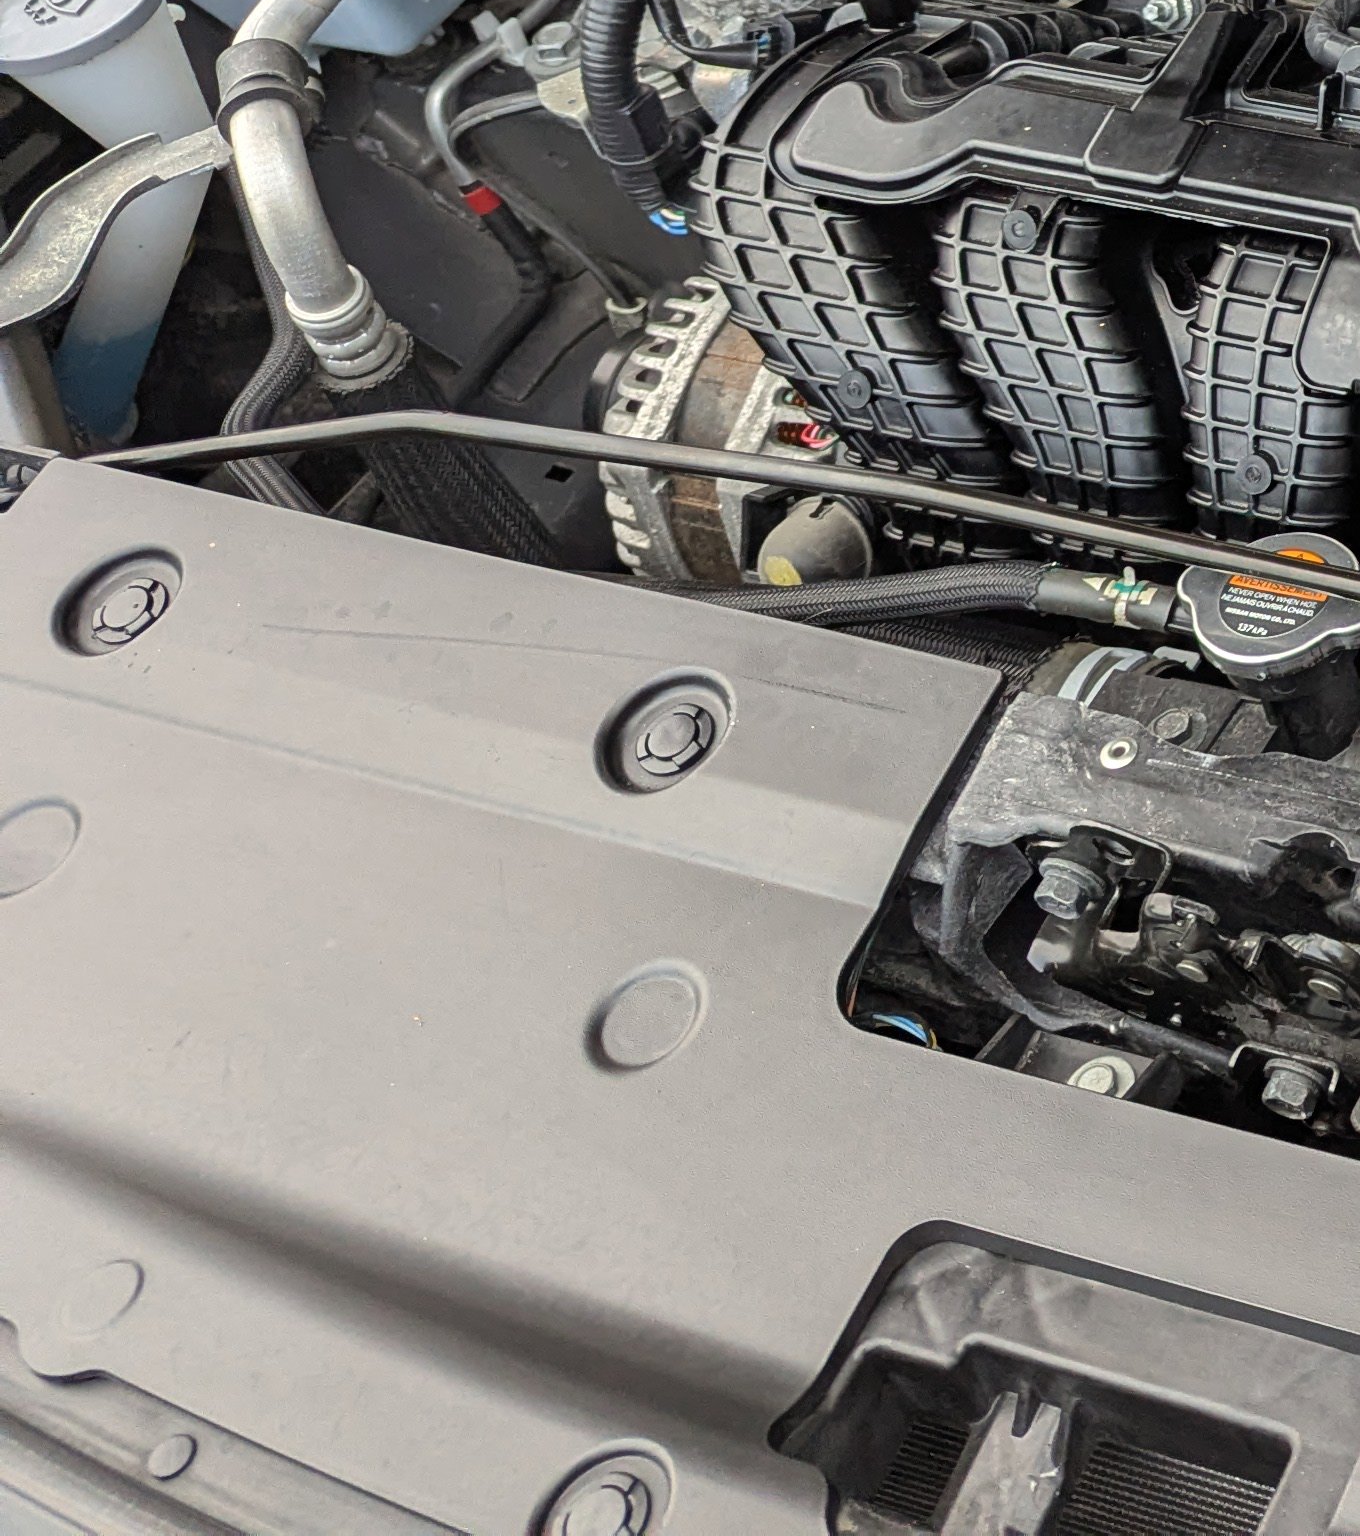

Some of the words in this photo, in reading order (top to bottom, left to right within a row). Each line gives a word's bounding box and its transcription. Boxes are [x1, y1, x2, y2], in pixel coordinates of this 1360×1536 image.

[1228, 586, 1253, 597] NEVER
[1253, 591, 1275, 601] OPEN
[1276, 596, 1299, 606] WHEN
[1234, 575, 1323, 599] AVERTISSEMENT
[1220, 593, 1233, 602] NE
[1232, 596, 1256, 607] JAMAIS
